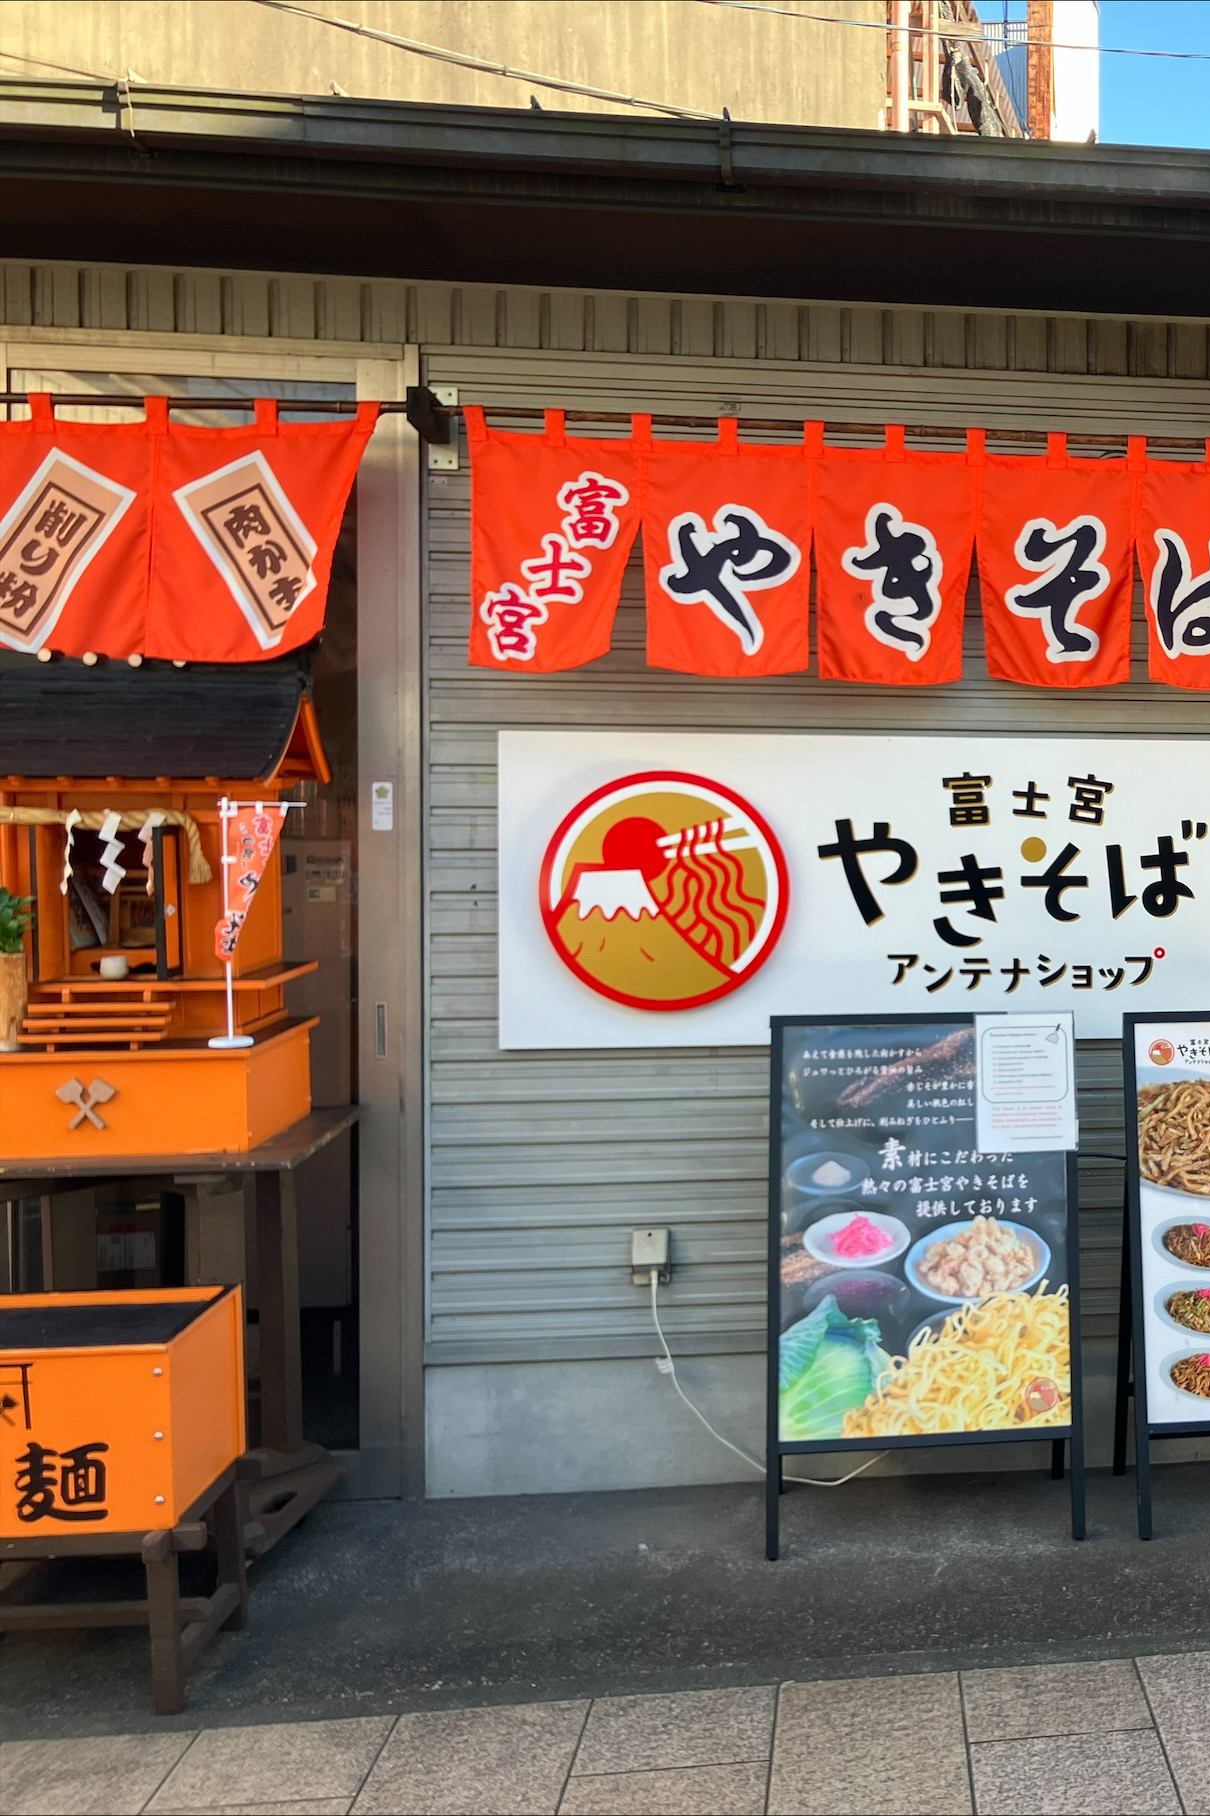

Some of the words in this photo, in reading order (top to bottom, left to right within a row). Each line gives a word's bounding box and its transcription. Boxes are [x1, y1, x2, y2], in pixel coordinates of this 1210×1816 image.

[0, 500, 88, 618] 削り粉
[480, 471, 630, 661] 富士宮
[942, 772, 1114, 826] 富士宮
[817, 818, 1208, 947] やきそば
[887, 946, 1166, 993] アンテナショップ
[878, 1137, 1014, 1172] 素材にこだわった
[861, 1174, 1029, 1196] 熱々の富士宮やきそばを
[915, 1197, 1038, 1218] 提供しております
